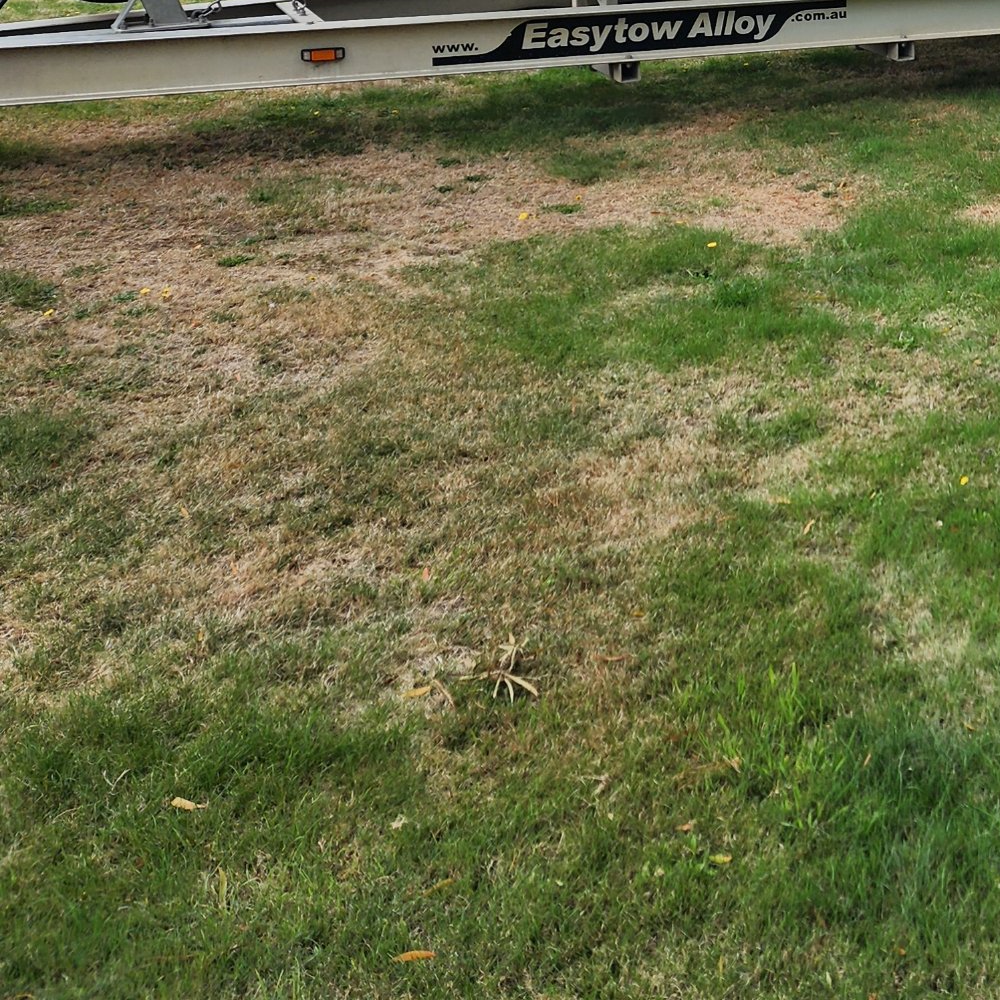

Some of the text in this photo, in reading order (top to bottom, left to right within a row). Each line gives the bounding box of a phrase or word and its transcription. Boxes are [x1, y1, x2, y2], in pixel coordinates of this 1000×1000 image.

[432, 10, 847, 54] www. Easytow Alloy .com.au
